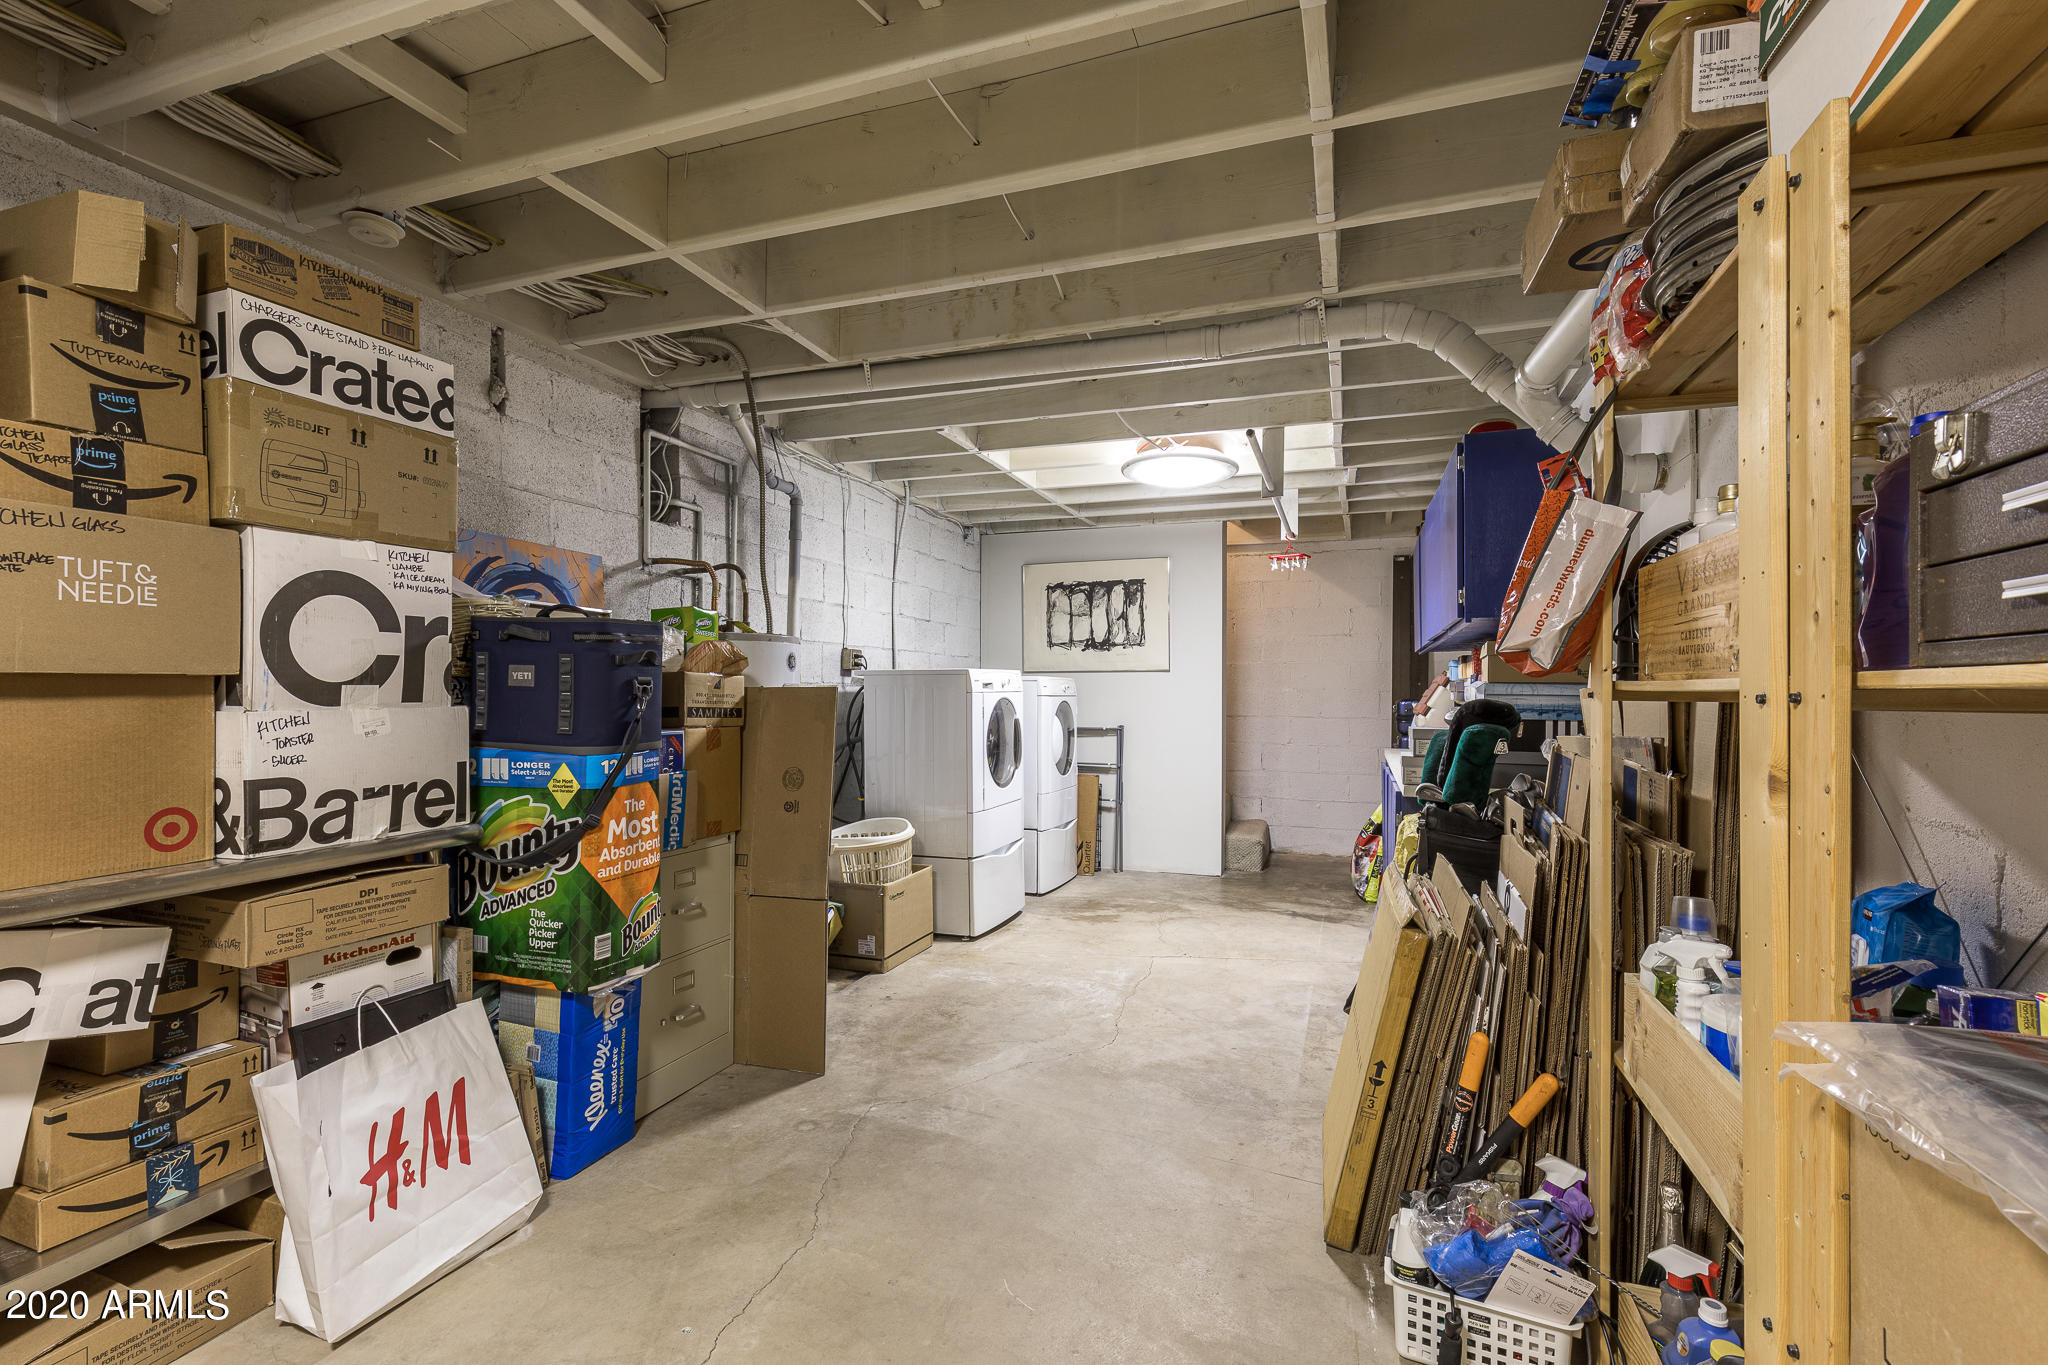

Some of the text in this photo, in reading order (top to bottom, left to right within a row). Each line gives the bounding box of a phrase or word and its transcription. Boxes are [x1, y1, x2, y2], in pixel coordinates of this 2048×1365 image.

[306, 321, 335, 339] CAKE
[336, 332, 369, 350] STAND
[378, 346, 396, 358] BLK
[58, 338, 180, 380] TUPPERWARE
[98, 392, 136, 406] prime
[286, 417, 331, 436] BEDJET
[76, 447, 117, 461] prime
[72, 516, 126, 534] GLASS
[388, 549, 430, 563] KITCHEN
[57, 579, 158, 606] NEEDLE
[1530, 528, 1595, 638] dunnedwards.com
[260, 570, 452, 706] Cr
[1680, 627, 1712, 641] CABERNET
[1678, 642, 1715, 655] SAUVIGNON
[511, 672, 532, 680] YETI
[692, 707, 737, 718] SAMPLES
[256, 712, 310, 739] KITCHEN
[272, 732, 314, 750] TOASTER
[624, 799, 646, 814] The
[608, 812, 658, 844] Most
[600, 836, 660, 863] Absorbent
[597, 852, 660, 878] and Durable
[360, 888, 378, 898] DPI
[480, 877, 556, 920] ADVANCED
[329, 903, 354, 912] SECURELY
[334, 907, 366, 918] DESTRUCTION
[529, 908, 546, 918] The
[528, 928, 557, 938] Picker
[529, 918, 564, 929] Quicker
[622, 897, 661, 957] Bount
[323, 932, 415, 966] KitchenAid
[528, 938, 556, 950] Upper
[146, 1074, 183, 1088] prime
[610, 1047, 619, 1104] trusted care
[584, 1040, 612, 1132] Kleenex
[1367, 1099, 1375, 1108] 3
[134, 1122, 170, 1145] prime
[1446, 1112, 1461, 1154] PowerGear
[360, 1076, 471, 1222] H&M
[1478, 1143, 1498, 1165] FISKARS
[92, 1324, 158, 1363] TAPE SECURELY AND
[117, 1332, 160, 1358] DESTRUCTION
[162, 1322, 180, 1334] WHEN
[149, 1331, 174, 1348] SCRIPT
